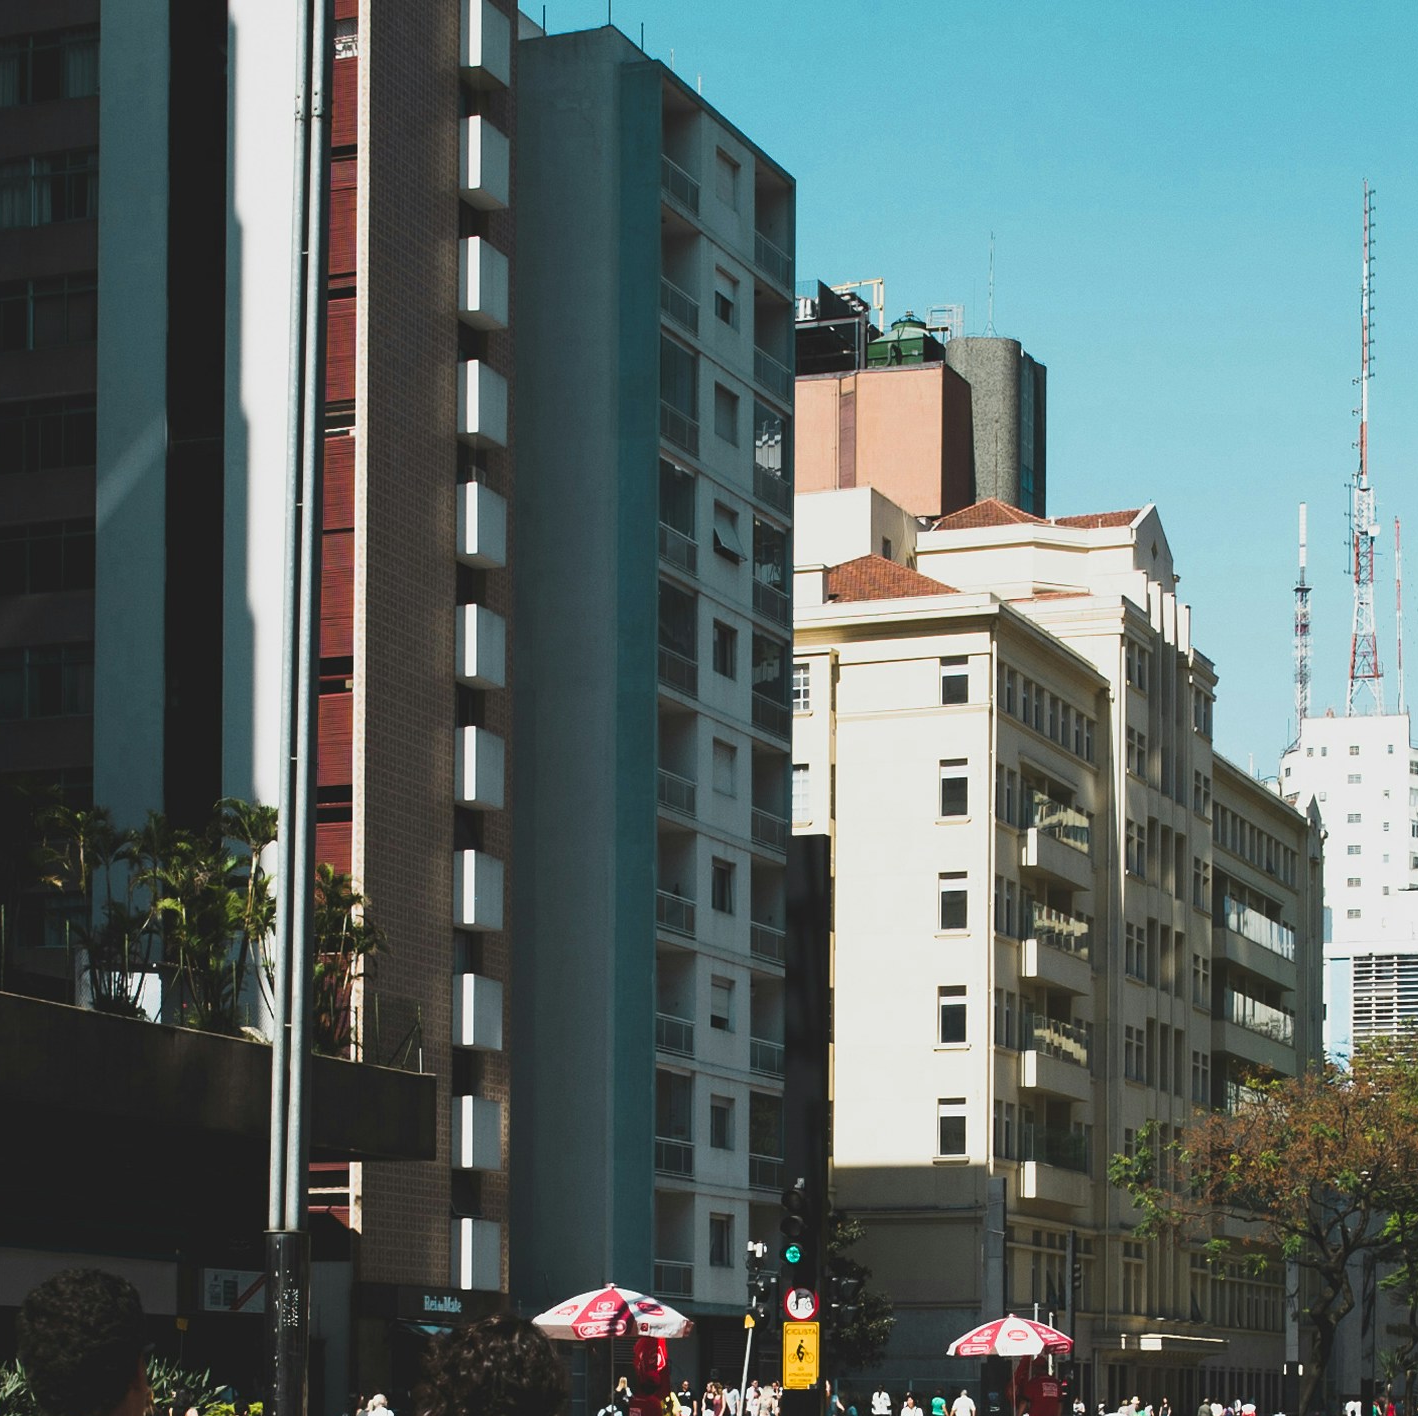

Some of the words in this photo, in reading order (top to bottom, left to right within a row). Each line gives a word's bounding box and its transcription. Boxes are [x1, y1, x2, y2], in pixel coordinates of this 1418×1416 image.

[424, 1296, 438, 1313] Rei
[446, 1297, 465, 1314] Mate
[786, 1328, 817, 1336] CICLISTA
